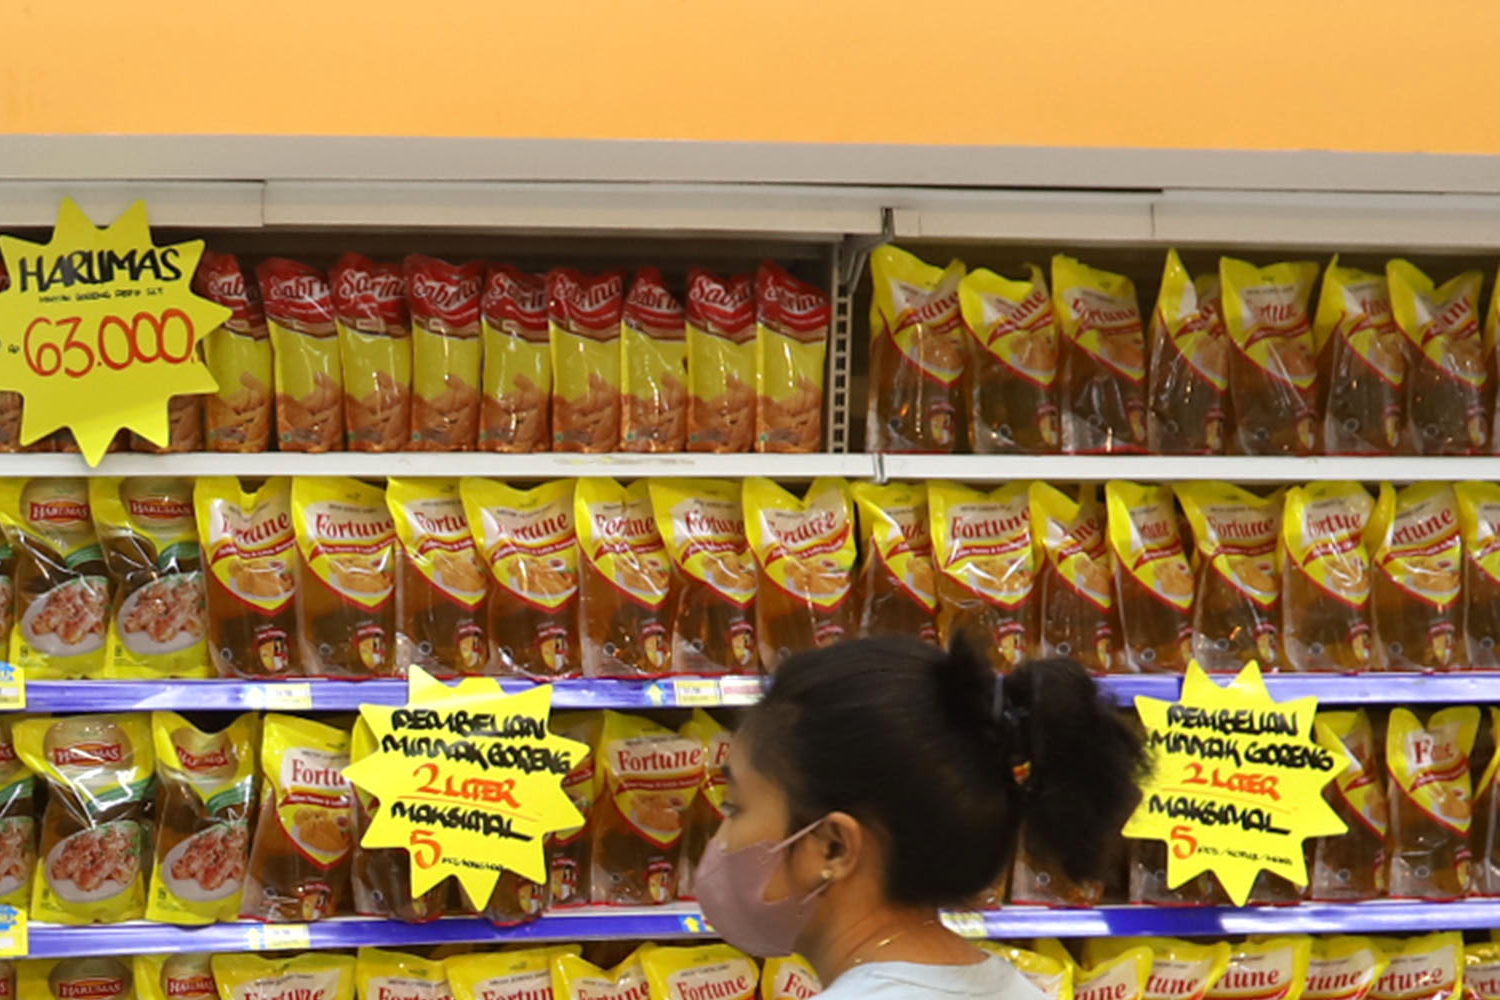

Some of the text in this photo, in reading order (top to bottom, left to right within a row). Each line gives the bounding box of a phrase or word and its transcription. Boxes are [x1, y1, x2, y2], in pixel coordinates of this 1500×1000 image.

[414, 511, 467, 537] Fortu
[291, 757, 352, 787] Fortu
[618, 748, 702, 773] Fortune
[1181, 762, 1209, 785] 2
[413, 763, 440, 795] 2
[410, 829, 443, 869] 5
[1170, 825, 1198, 860] 5
[1148, 974, 1199, 995] tune
